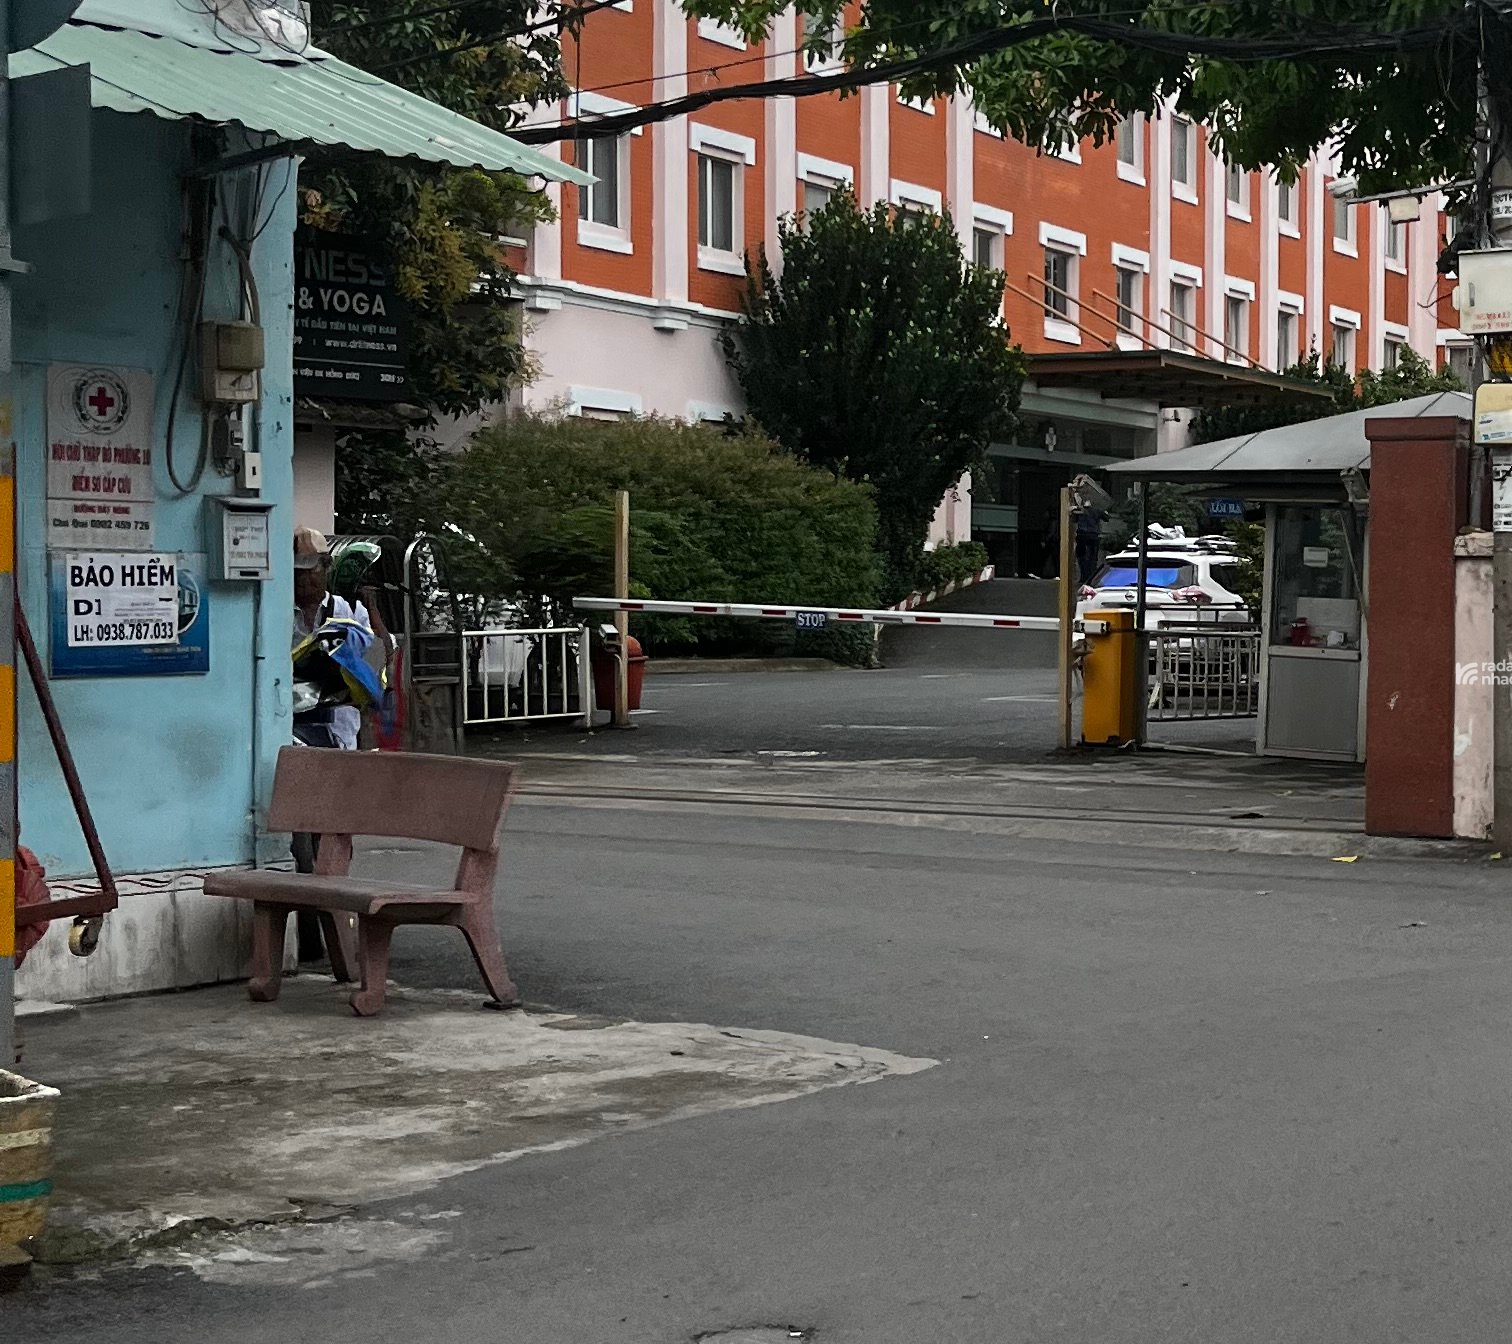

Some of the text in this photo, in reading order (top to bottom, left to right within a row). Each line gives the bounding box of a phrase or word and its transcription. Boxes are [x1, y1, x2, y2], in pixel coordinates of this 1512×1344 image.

[299, 287, 386, 316] & YOGA
[70, 558, 175, 587] BẢO HIỂM
[74, 621, 174, 642] LH: 0938.787.033
